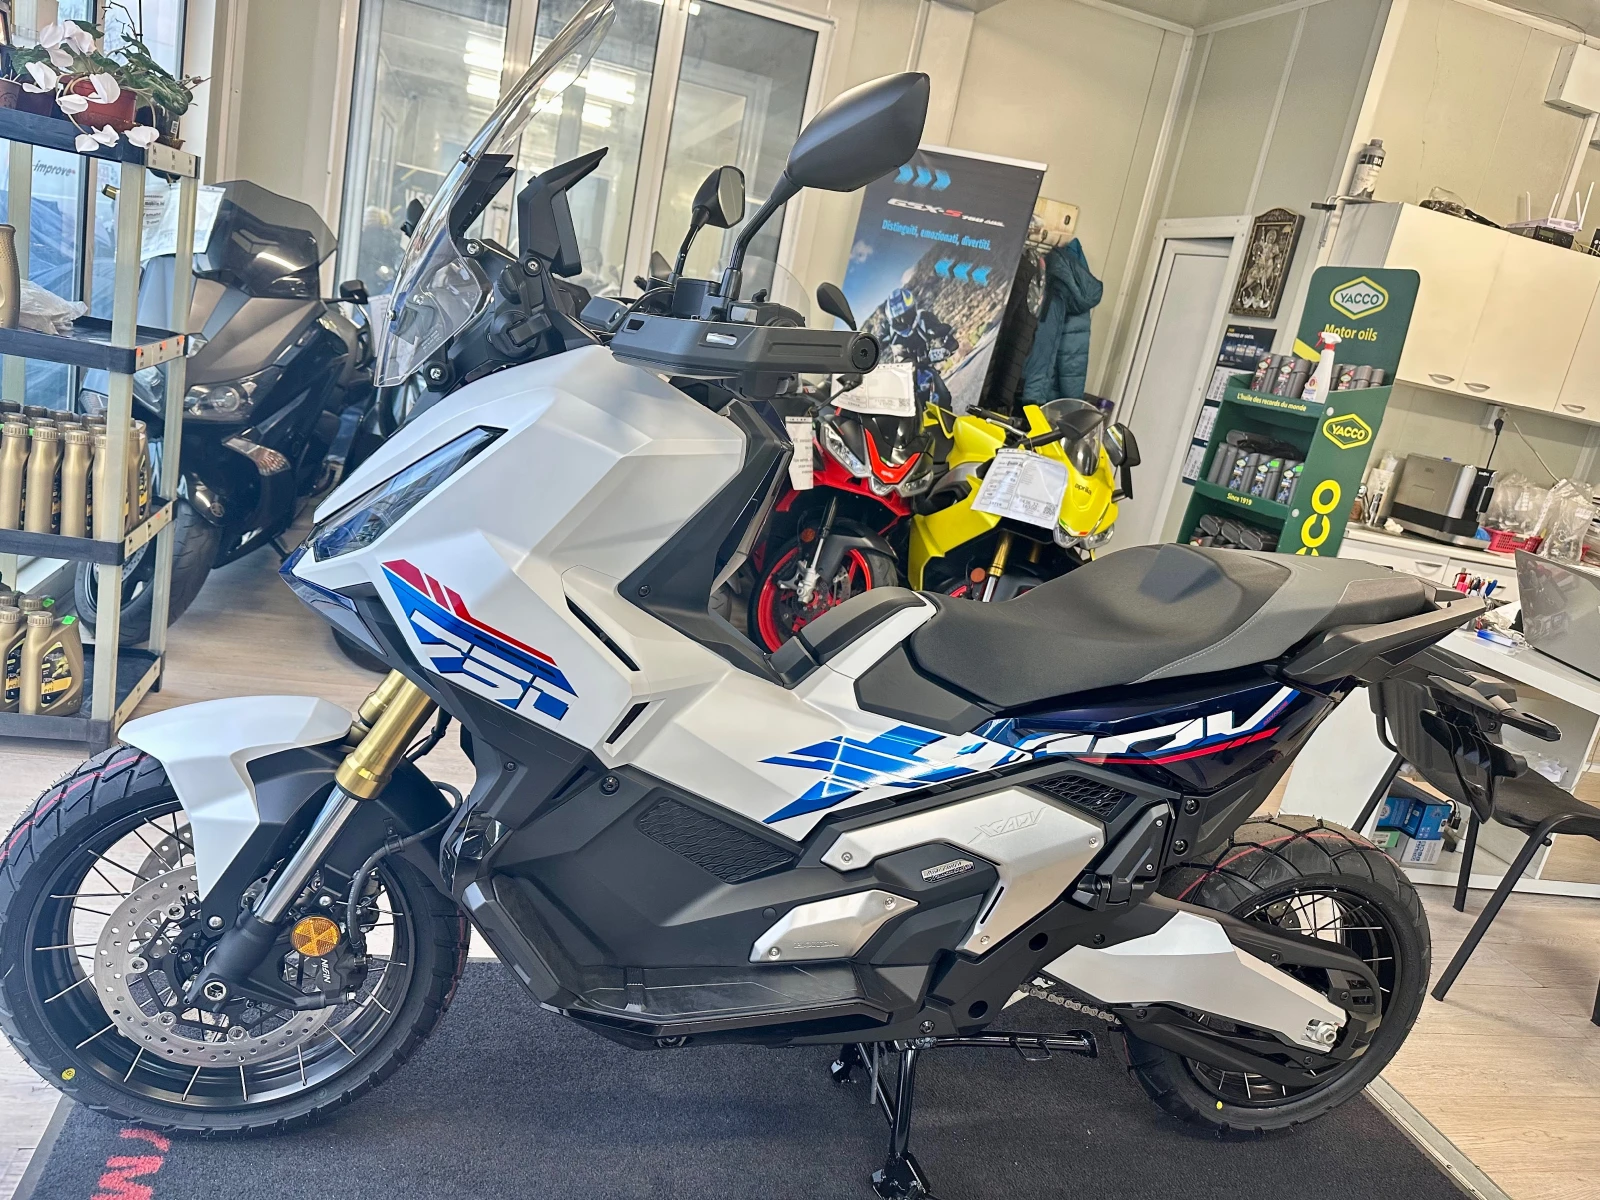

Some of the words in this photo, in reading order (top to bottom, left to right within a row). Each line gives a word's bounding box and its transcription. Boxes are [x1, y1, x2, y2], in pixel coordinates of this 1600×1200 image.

[881, 218, 919, 237] Distinguiti,
[920, 227, 960, 245] emozionati,
[961, 234, 991, 251] divertiti.
[1340, 291, 1380, 306] YACCO
[1324, 323, 1356, 339] Motor
[1358, 326, 1378, 342] oils
[1237, 392, 1253, 404] L'huile
[1253, 396, 1263, 406] des
[1263, 397, 1280, 410] records
[1280, 400, 1289, 410] du
[1288, 402, 1307, 413] monde
[1332, 424, 1366, 439] YACCO
[1226, 492, 1240, 504] Since
[1240, 495, 1253, 506] 1919
